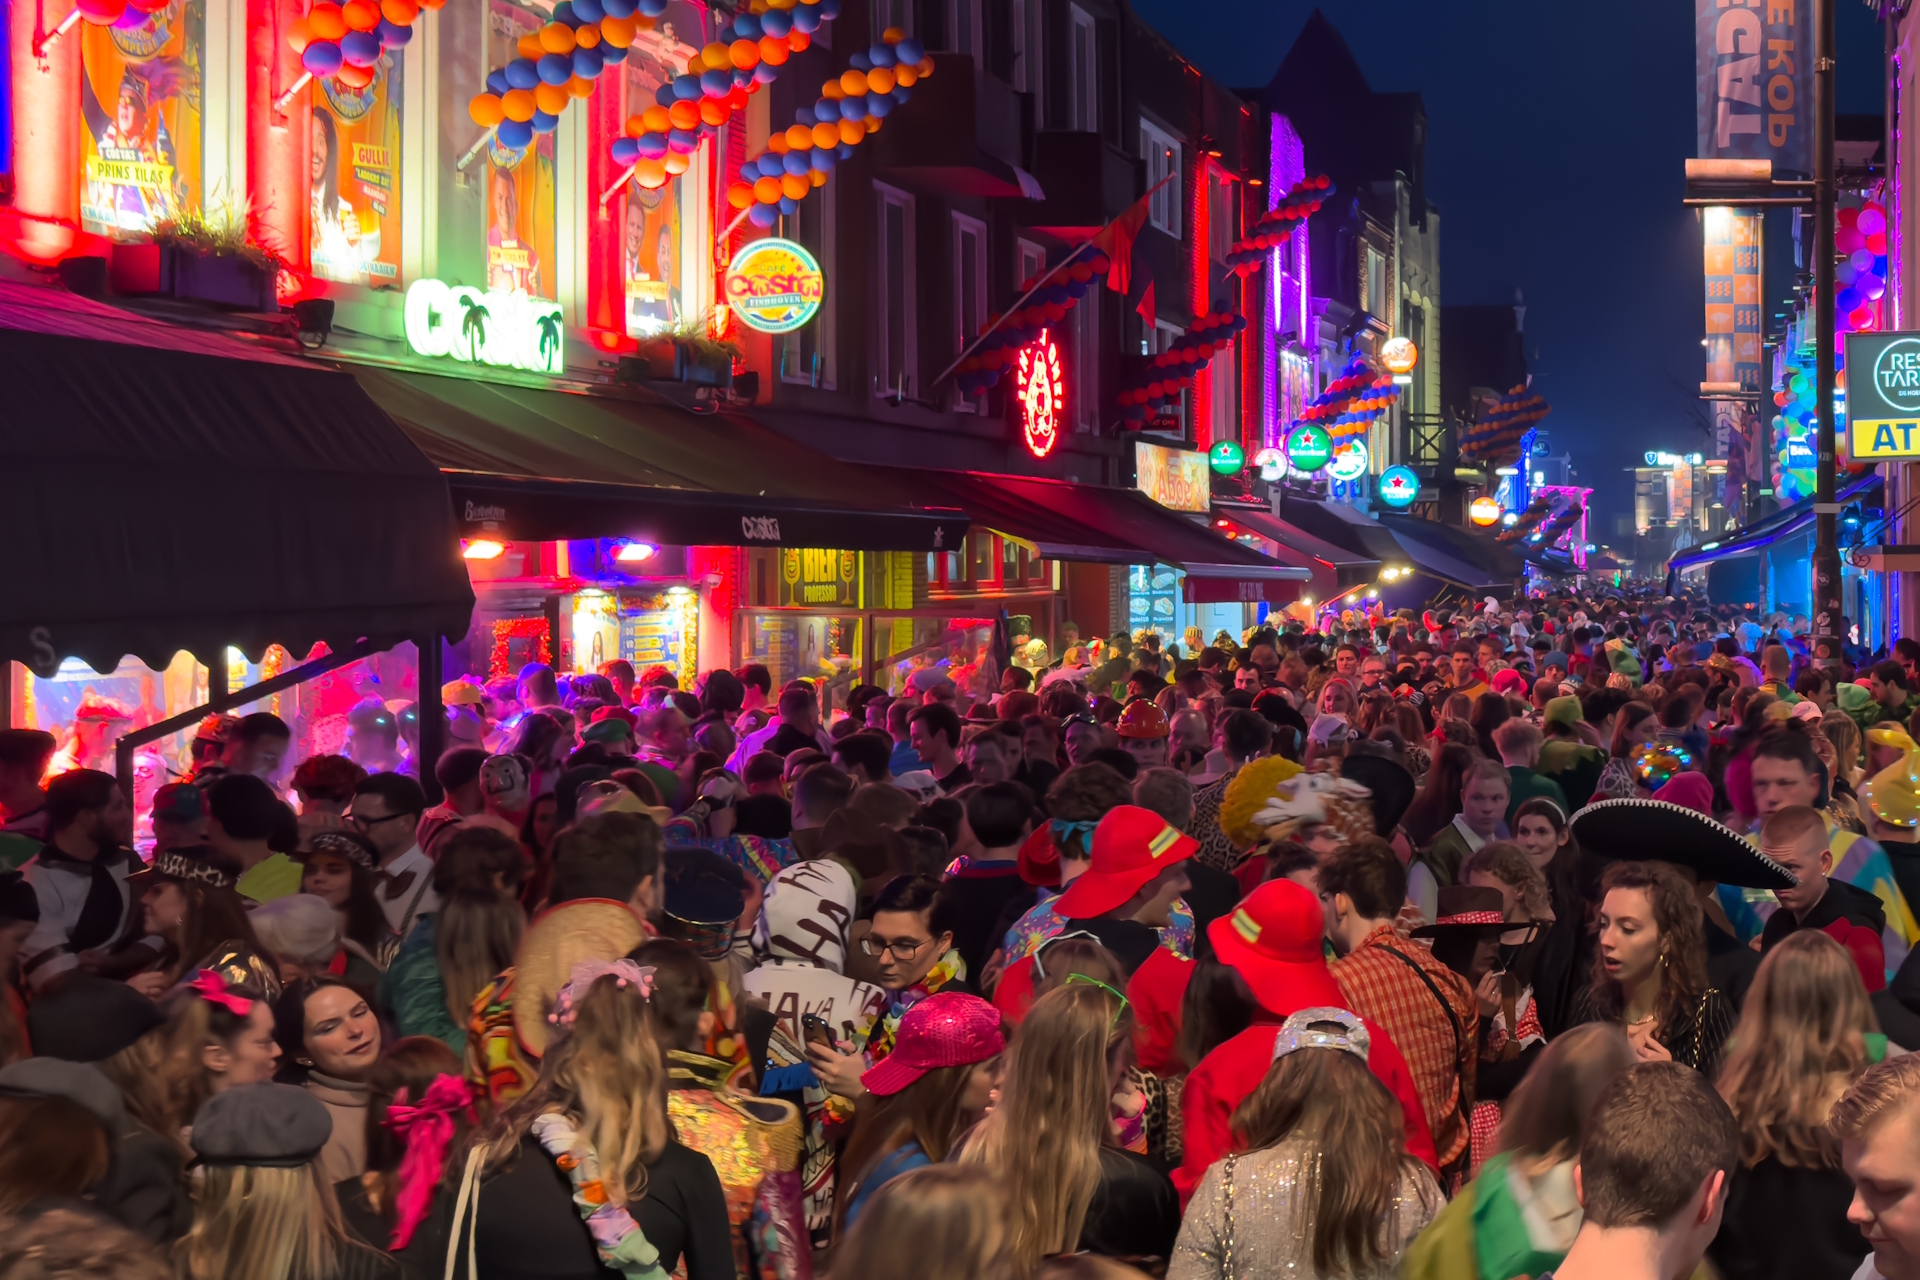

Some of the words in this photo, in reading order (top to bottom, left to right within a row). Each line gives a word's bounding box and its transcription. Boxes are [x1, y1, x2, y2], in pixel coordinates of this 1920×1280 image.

[98, 163, 129, 179] PRINS
[135, 167, 163, 184] XILAS
[761, 264, 787, 272] CAFÉ
[750, 295, 801, 307] EINDHOVEN
[1872, 423, 1917, 451] AT
[804, 548, 837, 583] BIER
